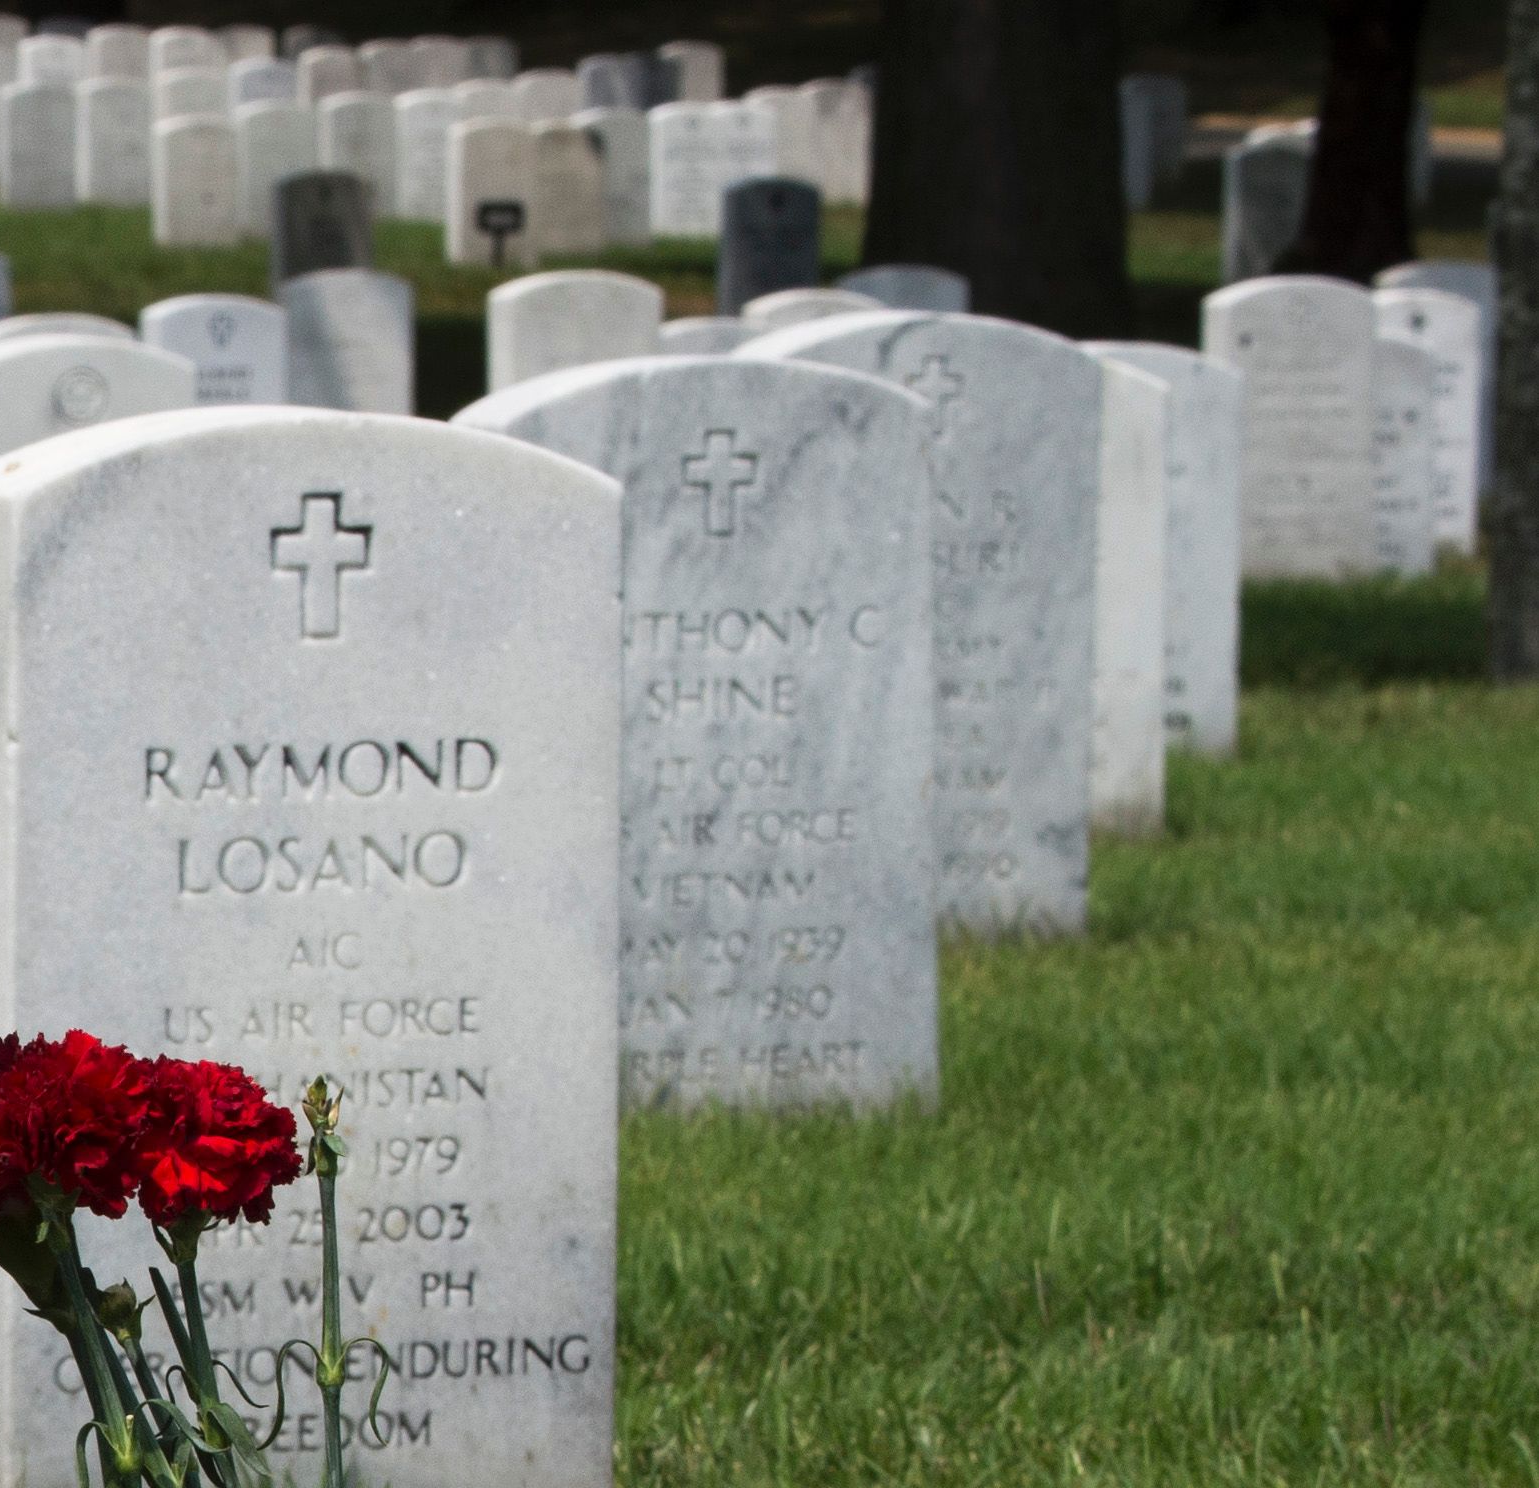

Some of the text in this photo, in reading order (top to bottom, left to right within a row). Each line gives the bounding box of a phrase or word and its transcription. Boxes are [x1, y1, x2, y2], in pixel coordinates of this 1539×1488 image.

[619, 603, 821, 652] THONY
[645, 673, 799, 724] SHINE
[143, 738, 499, 801] RAYMOND
[178, 830, 468, 896] LOSANO
[163, 995, 480, 1046] US AIR FORCE
[254, 1065, 490, 1108] HANISTAN
[372, 1134, 462, 1177] 1979
[197, 1217, 264, 1248] PR
[357, 1201, 471, 1245] 2003
[420, 1268, 477, 1308] PH
[344, 1333, 592, 1384] ENDURING
[243, 1408, 433, 1453] REEDOM
